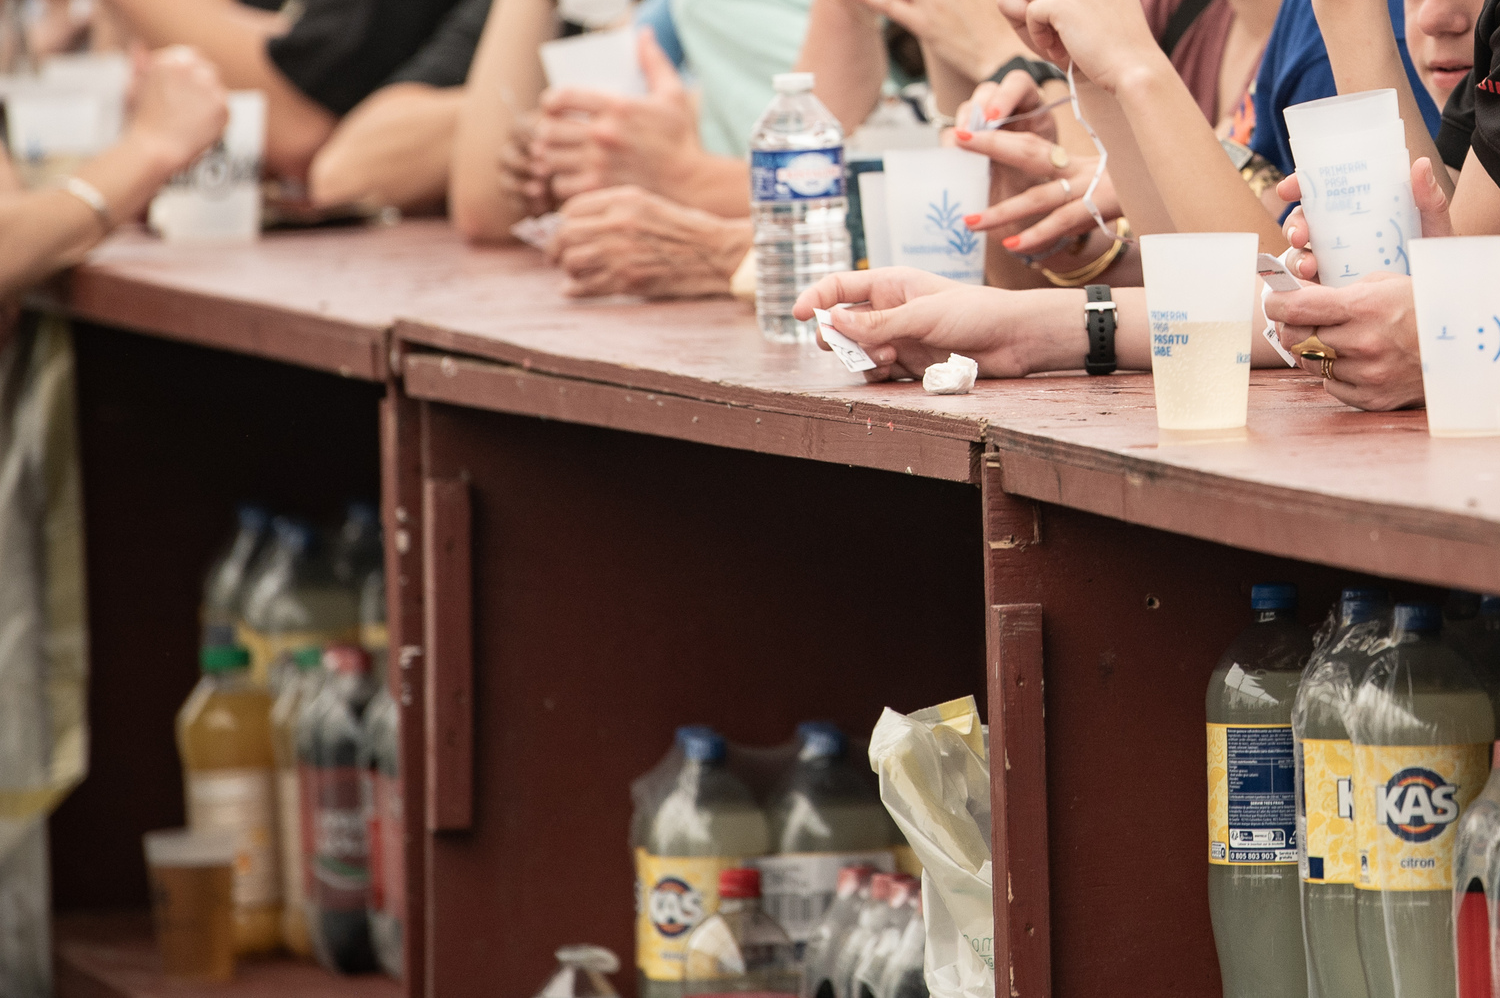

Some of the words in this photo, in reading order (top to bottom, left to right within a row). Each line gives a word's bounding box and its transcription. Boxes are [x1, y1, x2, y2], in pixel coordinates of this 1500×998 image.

[1319, 160, 1368, 177] PRIMERAN
[1324, 176, 1348, 188] PASA
[1154, 334, 1189, 345] PASATU
[1376, 784, 1460, 826] KAS
[1248, 852, 1260, 860] 803
[1261, 852, 1274, 860] 903
[1400, 857, 1435, 869] citron
